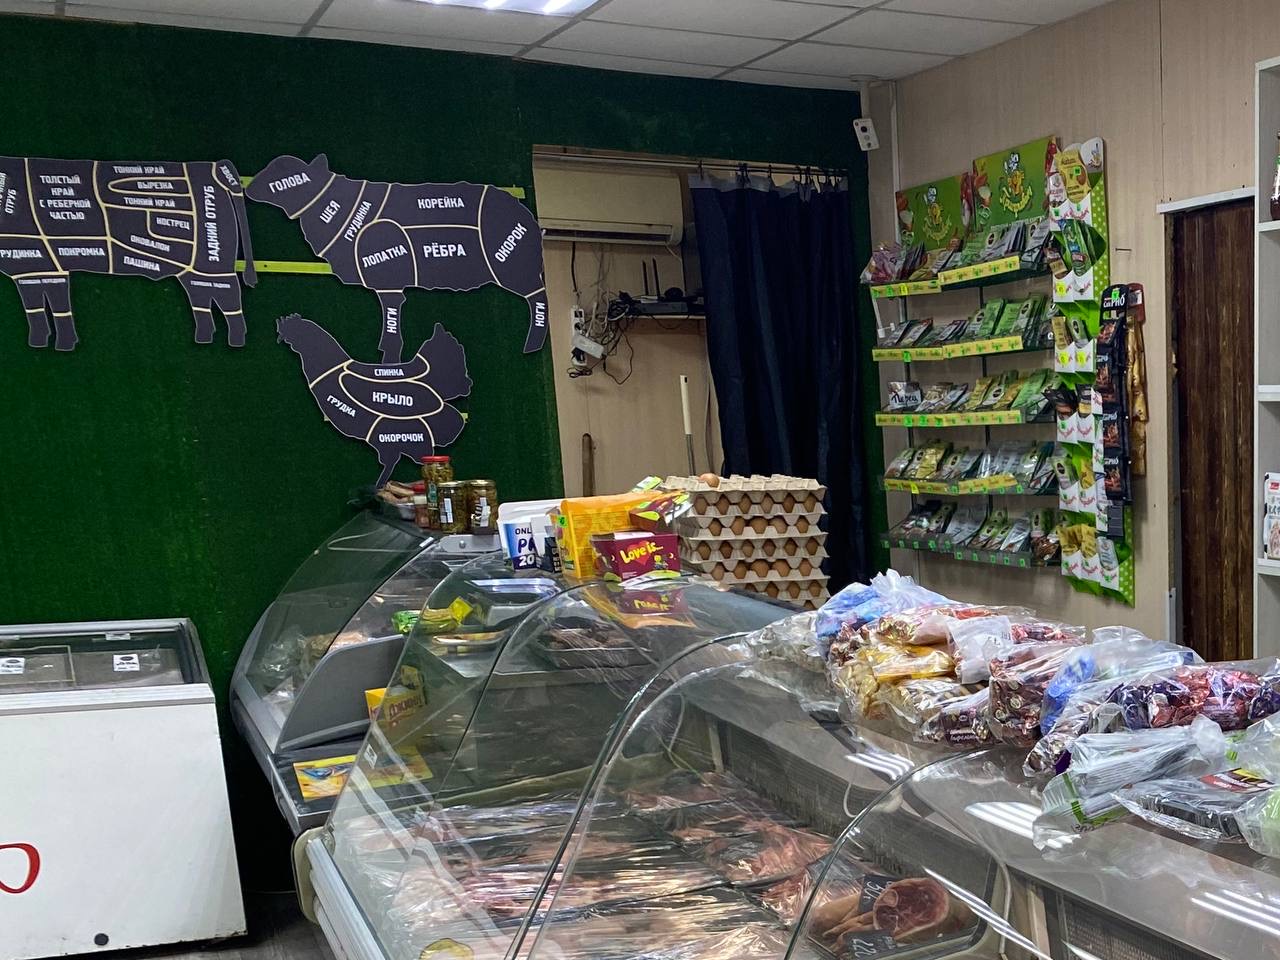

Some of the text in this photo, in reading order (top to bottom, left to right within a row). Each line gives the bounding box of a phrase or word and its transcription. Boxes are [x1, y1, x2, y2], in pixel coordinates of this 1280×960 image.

[144, 165, 165, 174] КРАЙ
[40, 174, 81, 184] ТОЛСТЫЙ
[137, 181, 174, 190] ВЫРЕЗКА
[269, 172, 311, 193] ГОЛОВА
[51, 187, 75, 196] КРАЙ
[5, 188, 17, 214] ОТРУБ
[47, 199, 92, 208] РЕБЕРНОЙ
[155, 198, 176, 207] КРАЙ
[418, 197, 464, 210] КОРЕЙКА
[50, 211, 85, 220] ЧАСТЬЮ
[320, 200, 341, 224] ШЕЯ
[156, 217, 190, 230] КОСТРЕЦ
[204, 185, 220, 262] ЗАДНИЙ ОТРУБ
[344, 200, 372, 242] ГРУДИНКА
[423, 243, 467, 258] РЁБРА
[495, 223, 527, 263] ОКОРОК
[0, 249, 43, 259] РУДИНКА
[58, 247, 105, 257] ПОКРОМКА
[362, 245, 408, 268] ЛОПАТКА
[123, 256, 160, 271] ПАШИНА
[387, 308, 397, 333] НОГИ
[536, 302, 545, 327] НОГИ
[374, 368, 404, 377] СПИНКА
[327, 394, 357, 417] ГРУДКА
[372, 392, 413, 407] КРЫЛО
[379, 433, 424, 443] ОКОРОЧОК
[620, 546, 646, 564] Love
